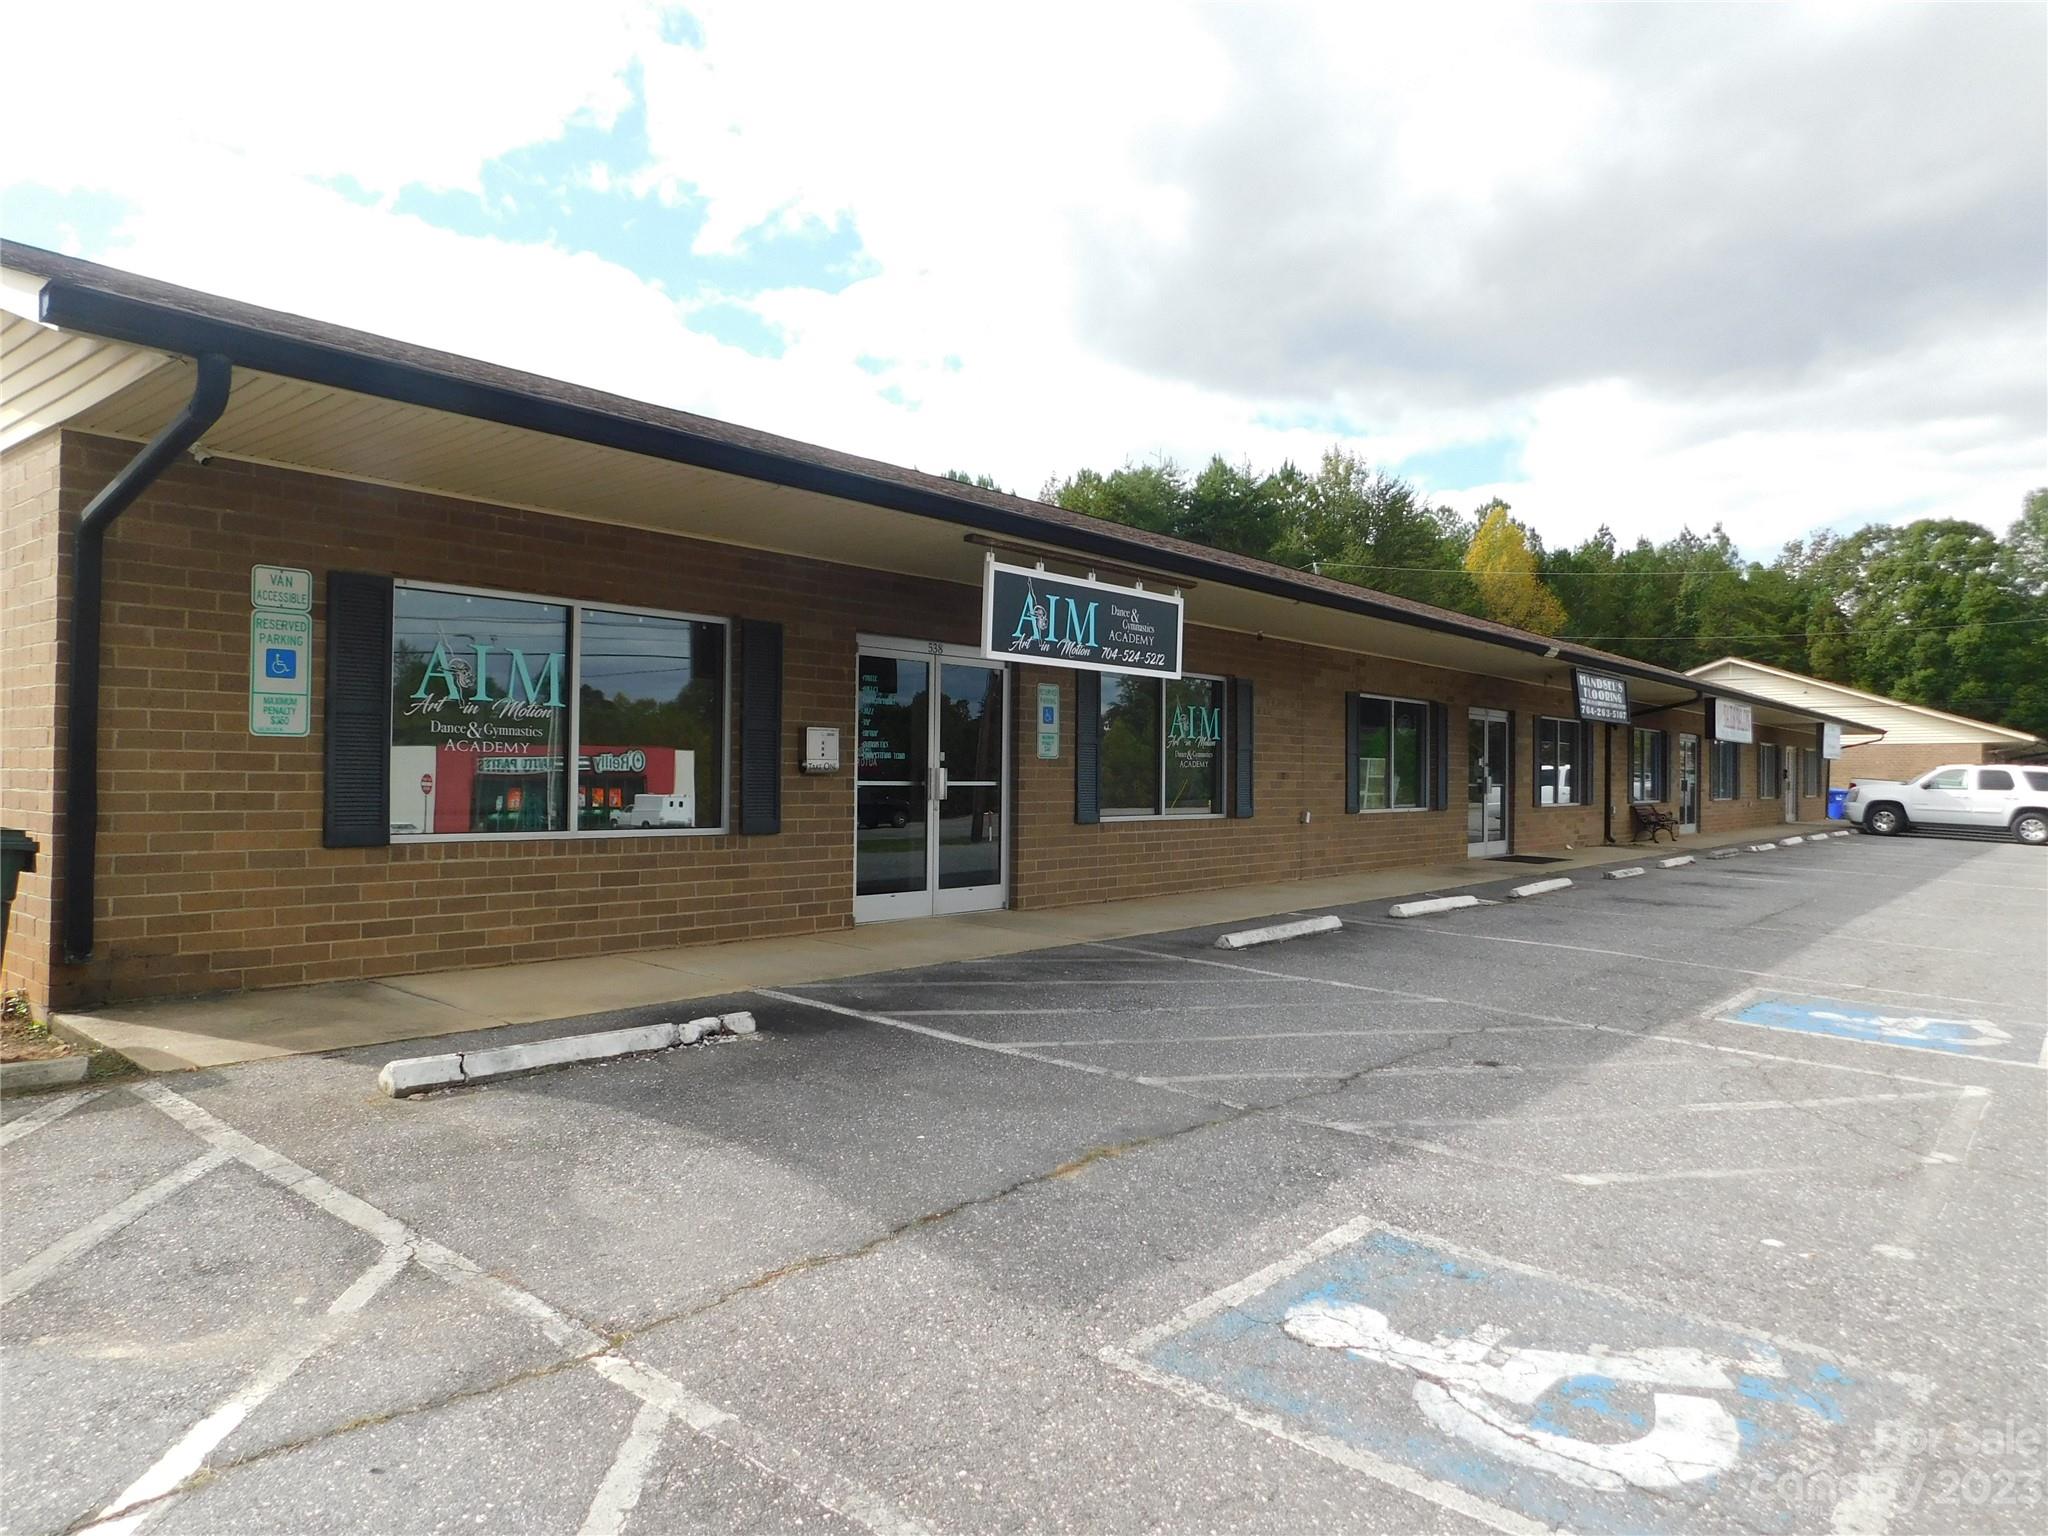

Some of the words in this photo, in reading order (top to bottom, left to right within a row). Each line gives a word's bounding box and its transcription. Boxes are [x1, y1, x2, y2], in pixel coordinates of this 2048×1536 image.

[270, 574, 294, 588] VAN
[256, 590, 307, 605] ACCESSIBLE
[1011, 591, 1099, 647] AIM
[1111, 604, 1131, 618] Dance
[1130, 608, 1140, 623] &
[255, 618, 307, 633] RESERVED
[1122, 618, 1155, 633] Gymnastics
[259, 633, 304, 647] PARKING
[1008, 633, 1033, 651] Art
[1040, 640, 1050, 652] in
[1057, 638, 1091, 658] Motion
[1108, 630, 1155, 646] ACADEMY
[928, 642, 944, 654] 538
[1101, 646, 1166, 666] 704-524-5212
[409, 641, 567, 708] AIM
[1583, 687, 1622, 704] FLOORING
[263, 706, 297, 715] PENALTY
[403, 693, 446, 716] Art
[461, 700, 480, 715] in
[491, 697, 553, 720] Motion
[430, 720, 467, 734] Dance
[467, 721, 483, 739] &
[483, 722, 544, 738] Gymnastics
[1167, 704, 1221, 741] AIM
[444, 739, 531, 754] ACADEMY
[1179, 759, 1209, 768] ACADEMY
